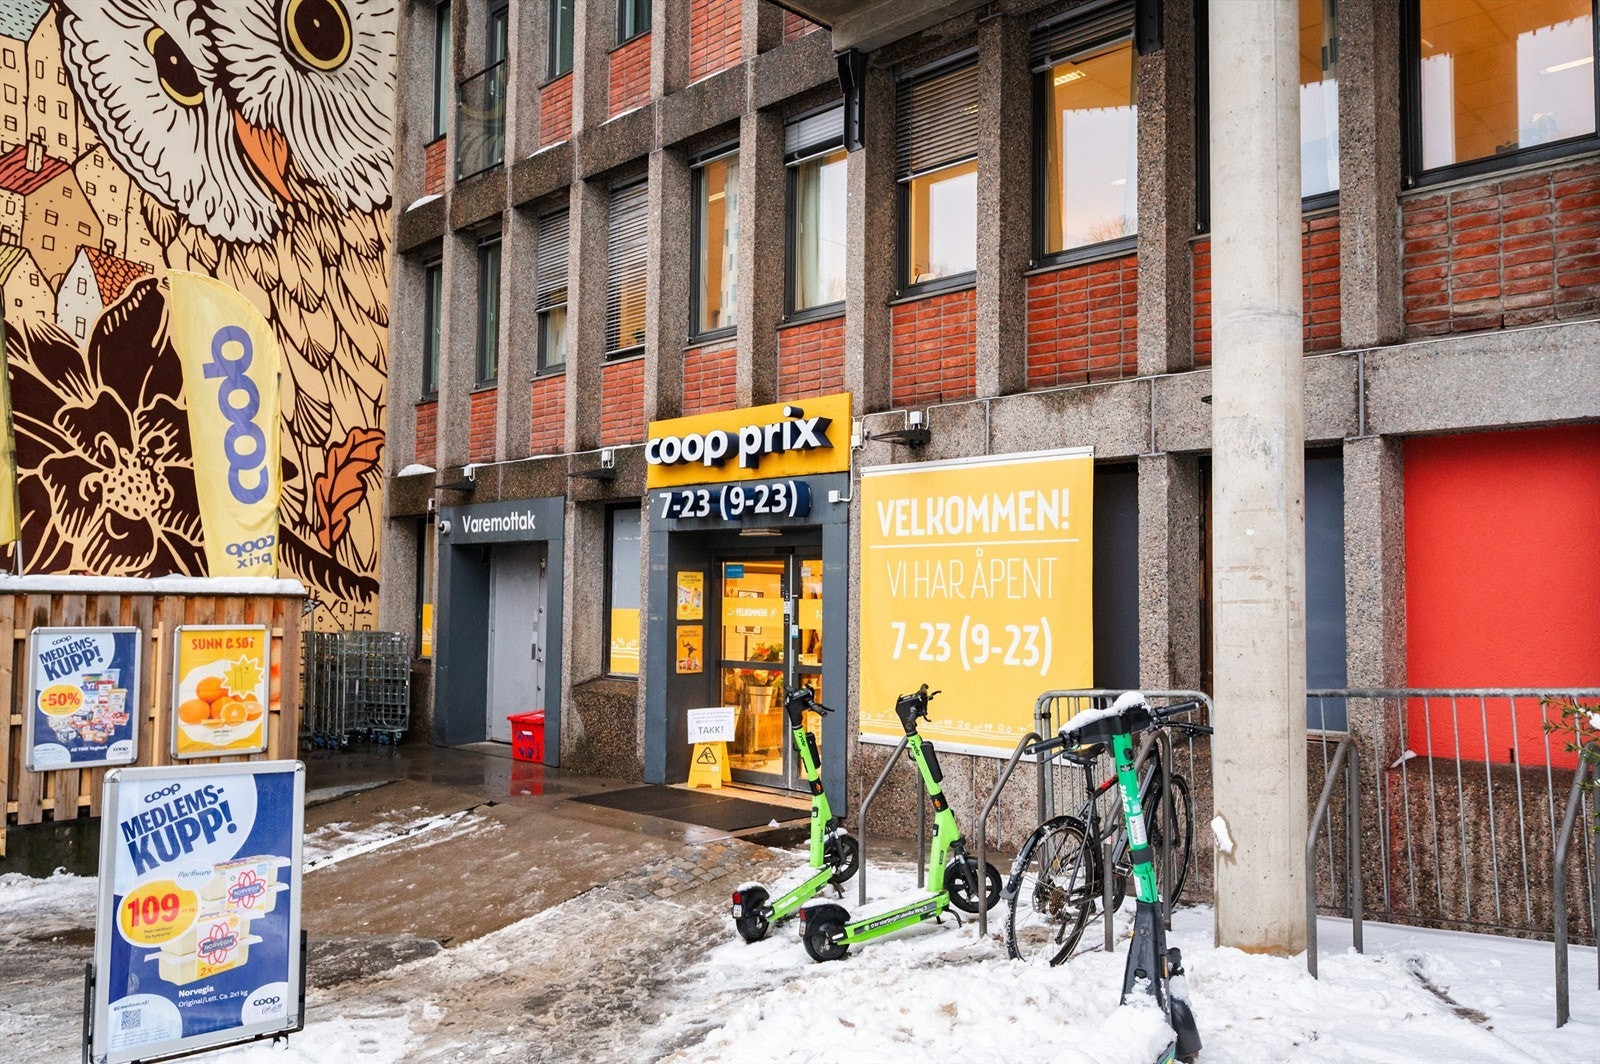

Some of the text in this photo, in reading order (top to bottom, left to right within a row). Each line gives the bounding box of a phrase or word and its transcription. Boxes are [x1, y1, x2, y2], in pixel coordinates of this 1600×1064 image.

[645, 405, 822, 468] coop prix
[659, 480, 797, 521] 7-23 (9-23)
[877, 488, 1069, 537] VELKOMMEN!
[462, 510, 536, 533] Varemottak
[886, 547, 1058, 599] VI HAR ÅPENT
[39, 637, 96, 665] MEDLEMS-
[51, 635, 72, 645] coop
[192, 638, 222, 650] SUNN
[226, 637, 234, 649] &
[891, 615, 1052, 677] 7-23 (9-23)
[43, 645, 104, 681] KUPP!
[42, 692, 80, 707] -50%
[698, 725, 724, 735] TAKK!
[144, 783, 181, 804] coop
[120, 785, 225, 843] MEDLEMS-
[127, 800, 237, 877] KUPP!
[128, 893, 180, 928] 109
[253, 996, 280, 1007] coop
